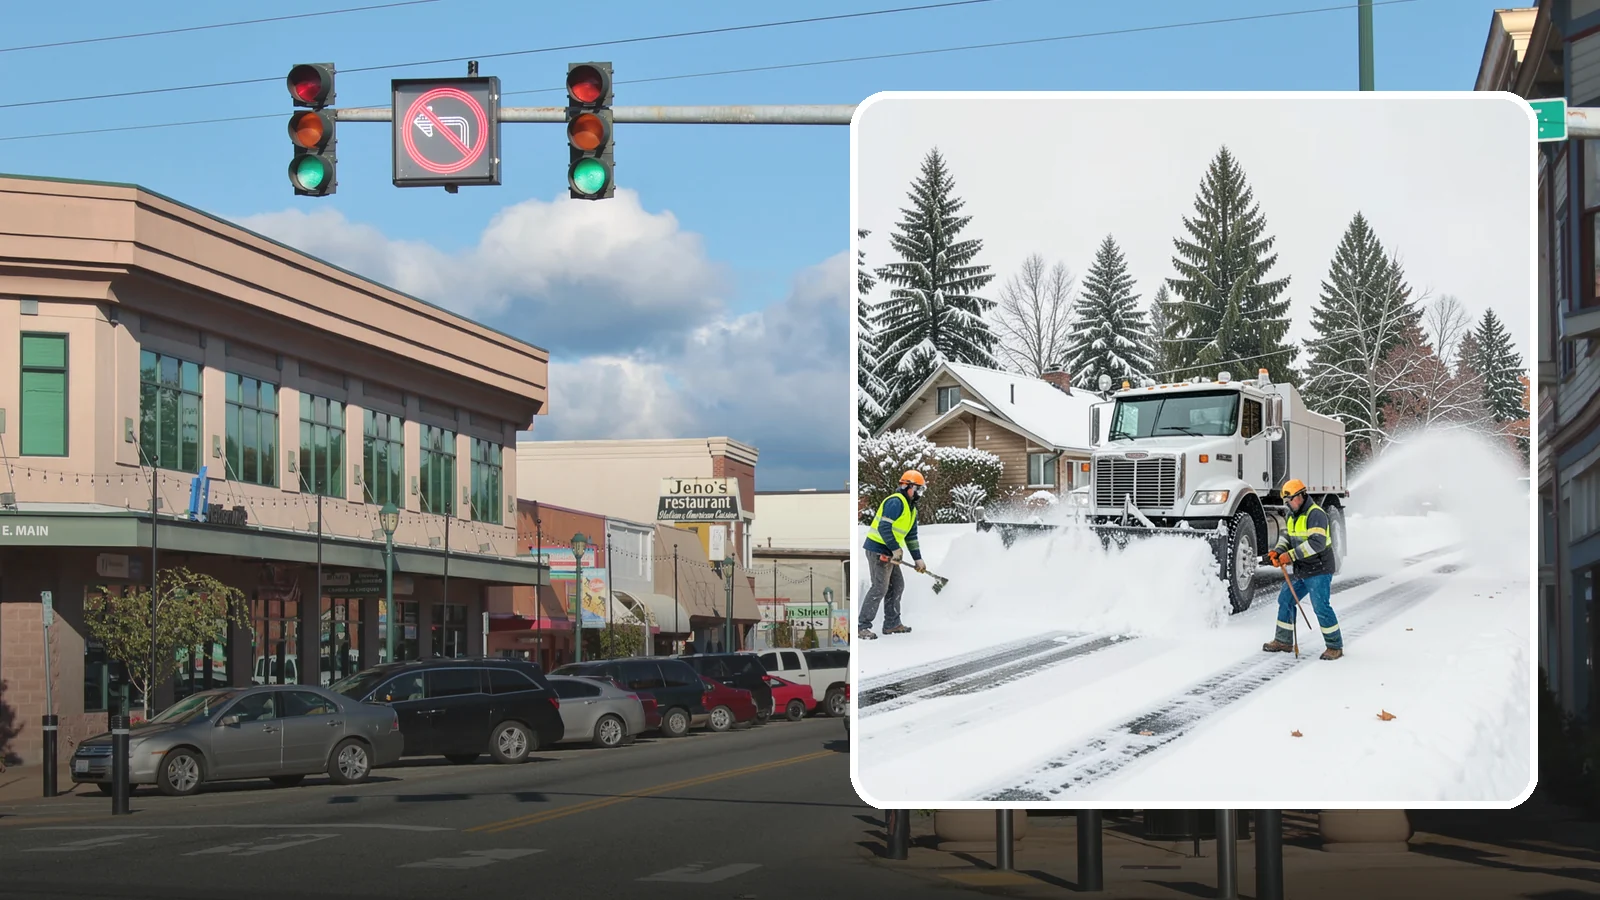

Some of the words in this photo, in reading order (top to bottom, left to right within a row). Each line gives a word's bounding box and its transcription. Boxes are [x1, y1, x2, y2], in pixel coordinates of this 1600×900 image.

[669, 480, 727, 494] Jeno's
[665, 496, 731, 509] restaurant
[658, 509, 682, 520] Italian
[686, 510, 714, 519] American
[715, 509, 737, 519] Cuisine
[2, 525, 13, 536] E.
[15, 525, 49, 536] MAIN
[797, 607, 828, 617] Street
[790, 619, 823, 627] lass
